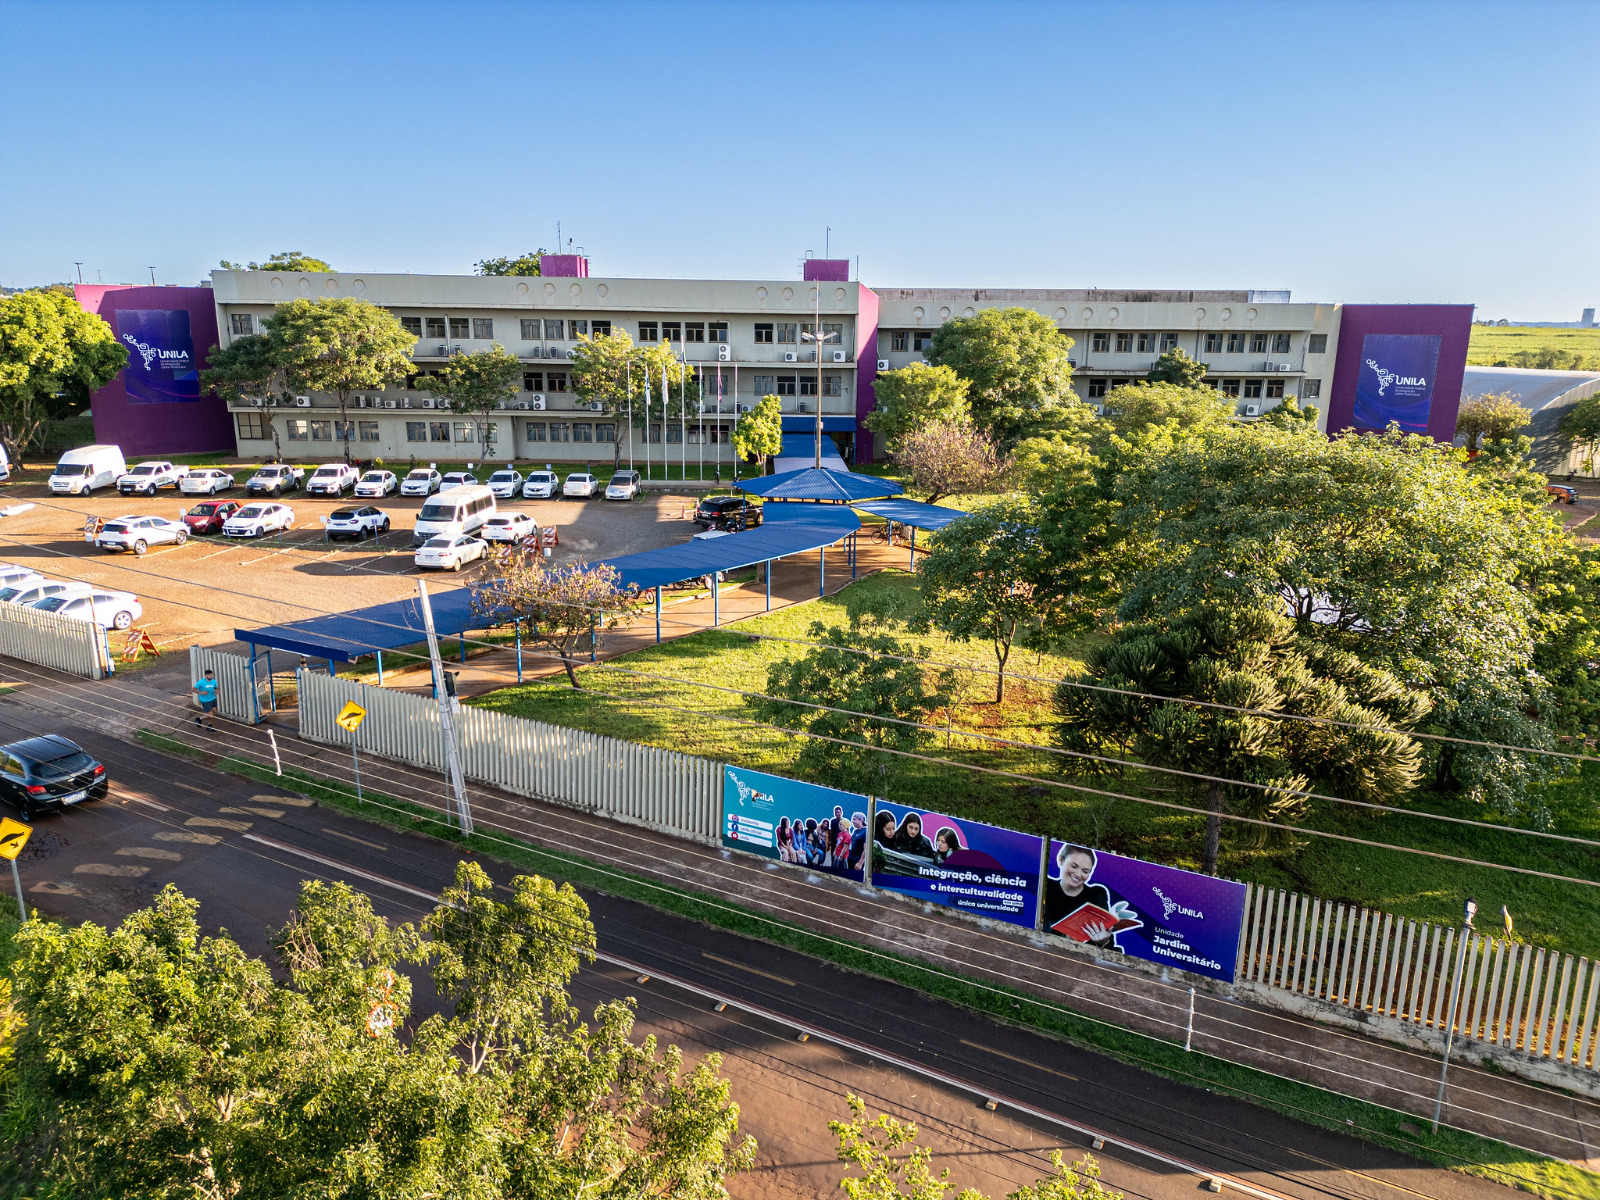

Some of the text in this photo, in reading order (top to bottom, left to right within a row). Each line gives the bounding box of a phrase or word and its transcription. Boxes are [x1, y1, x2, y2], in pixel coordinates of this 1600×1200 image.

[157, 348, 189, 358] UNILA
[1396, 374, 1426, 386] UNILA
[919, 866, 1027, 887] Integração, ciência
[930, 883, 1024, 901] e interculturalidade
[957, 899, 976, 907] única
[976, 902, 1019, 913] universidade
[1178, 904, 1204, 919] UNILA
[1154, 926, 1184, 939] Unidade
[1153, 935, 1190, 951] Jardim
[1152, 945, 1221, 970] Universitário
